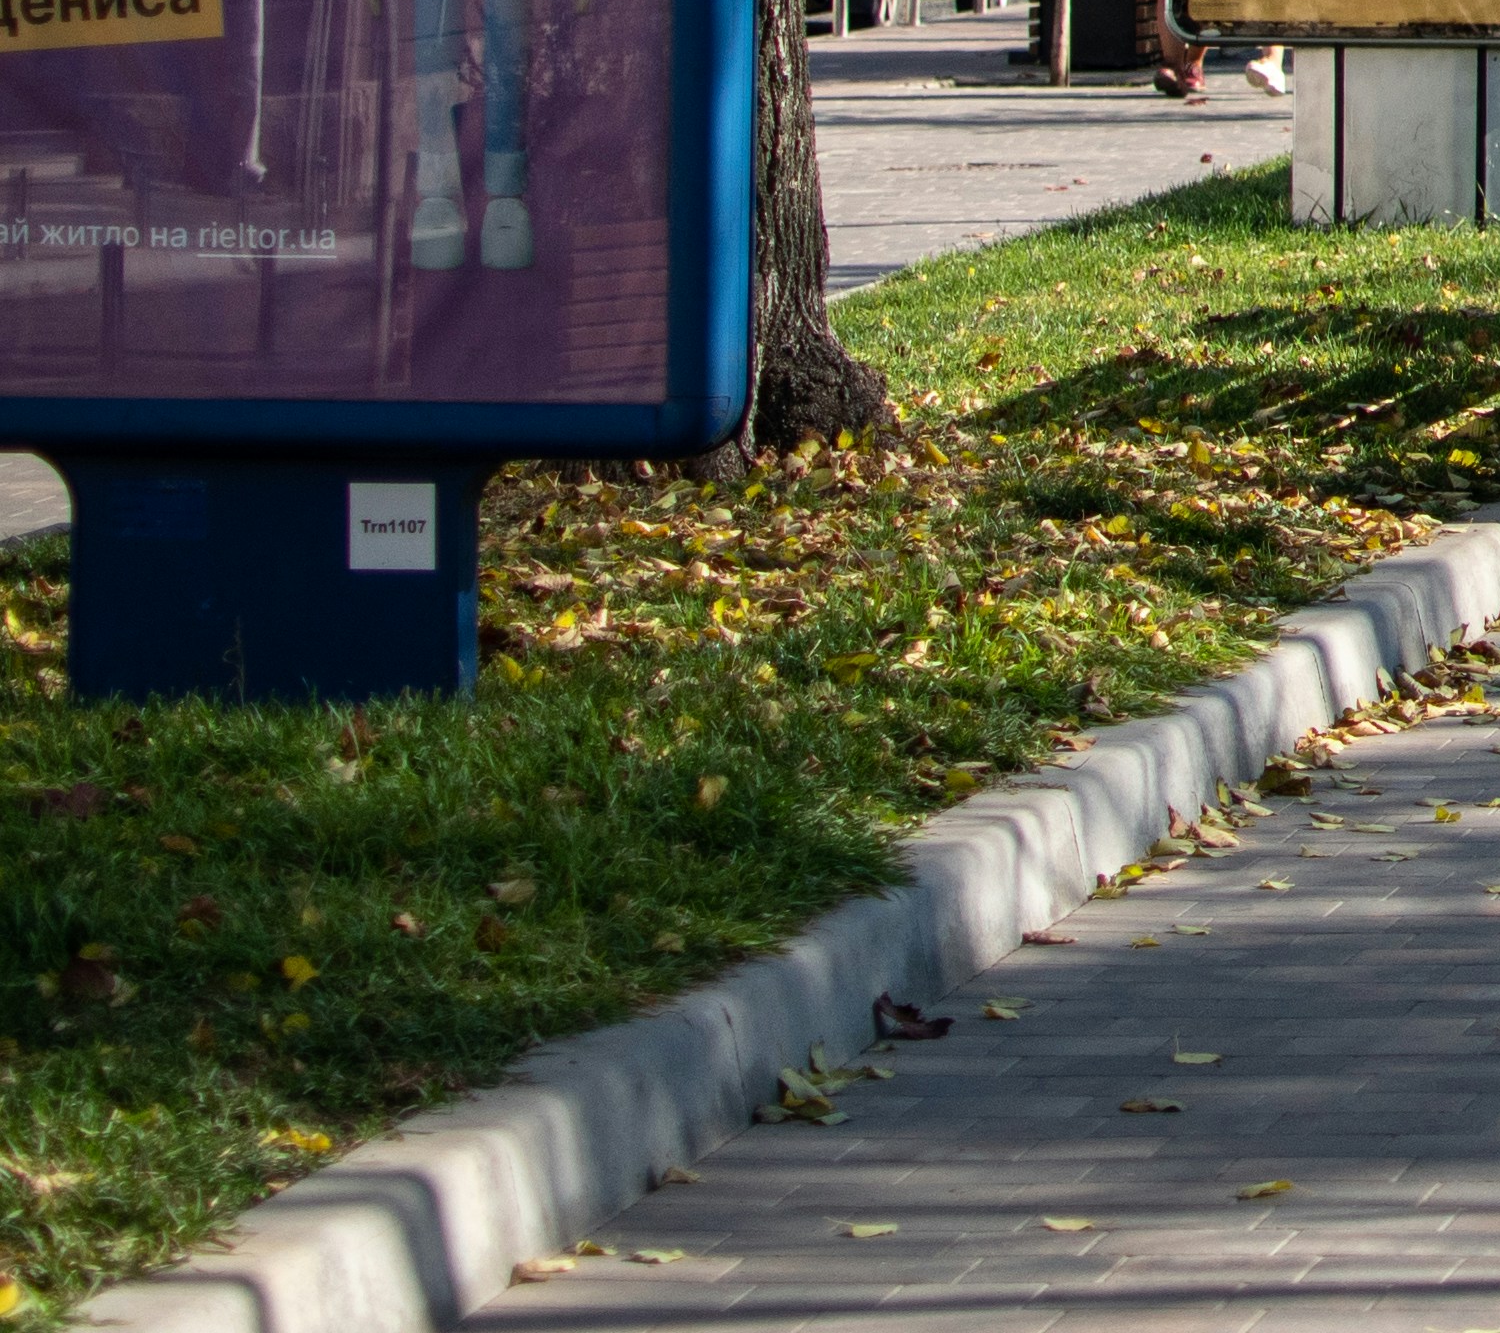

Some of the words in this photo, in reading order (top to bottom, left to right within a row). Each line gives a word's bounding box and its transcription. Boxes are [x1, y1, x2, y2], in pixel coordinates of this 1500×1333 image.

[40, 224, 140, 247] житло
[150, 226, 188, 248] на
[199, 220, 336, 250] rieltor.ua
[360, 518, 427, 534] Trn1107
